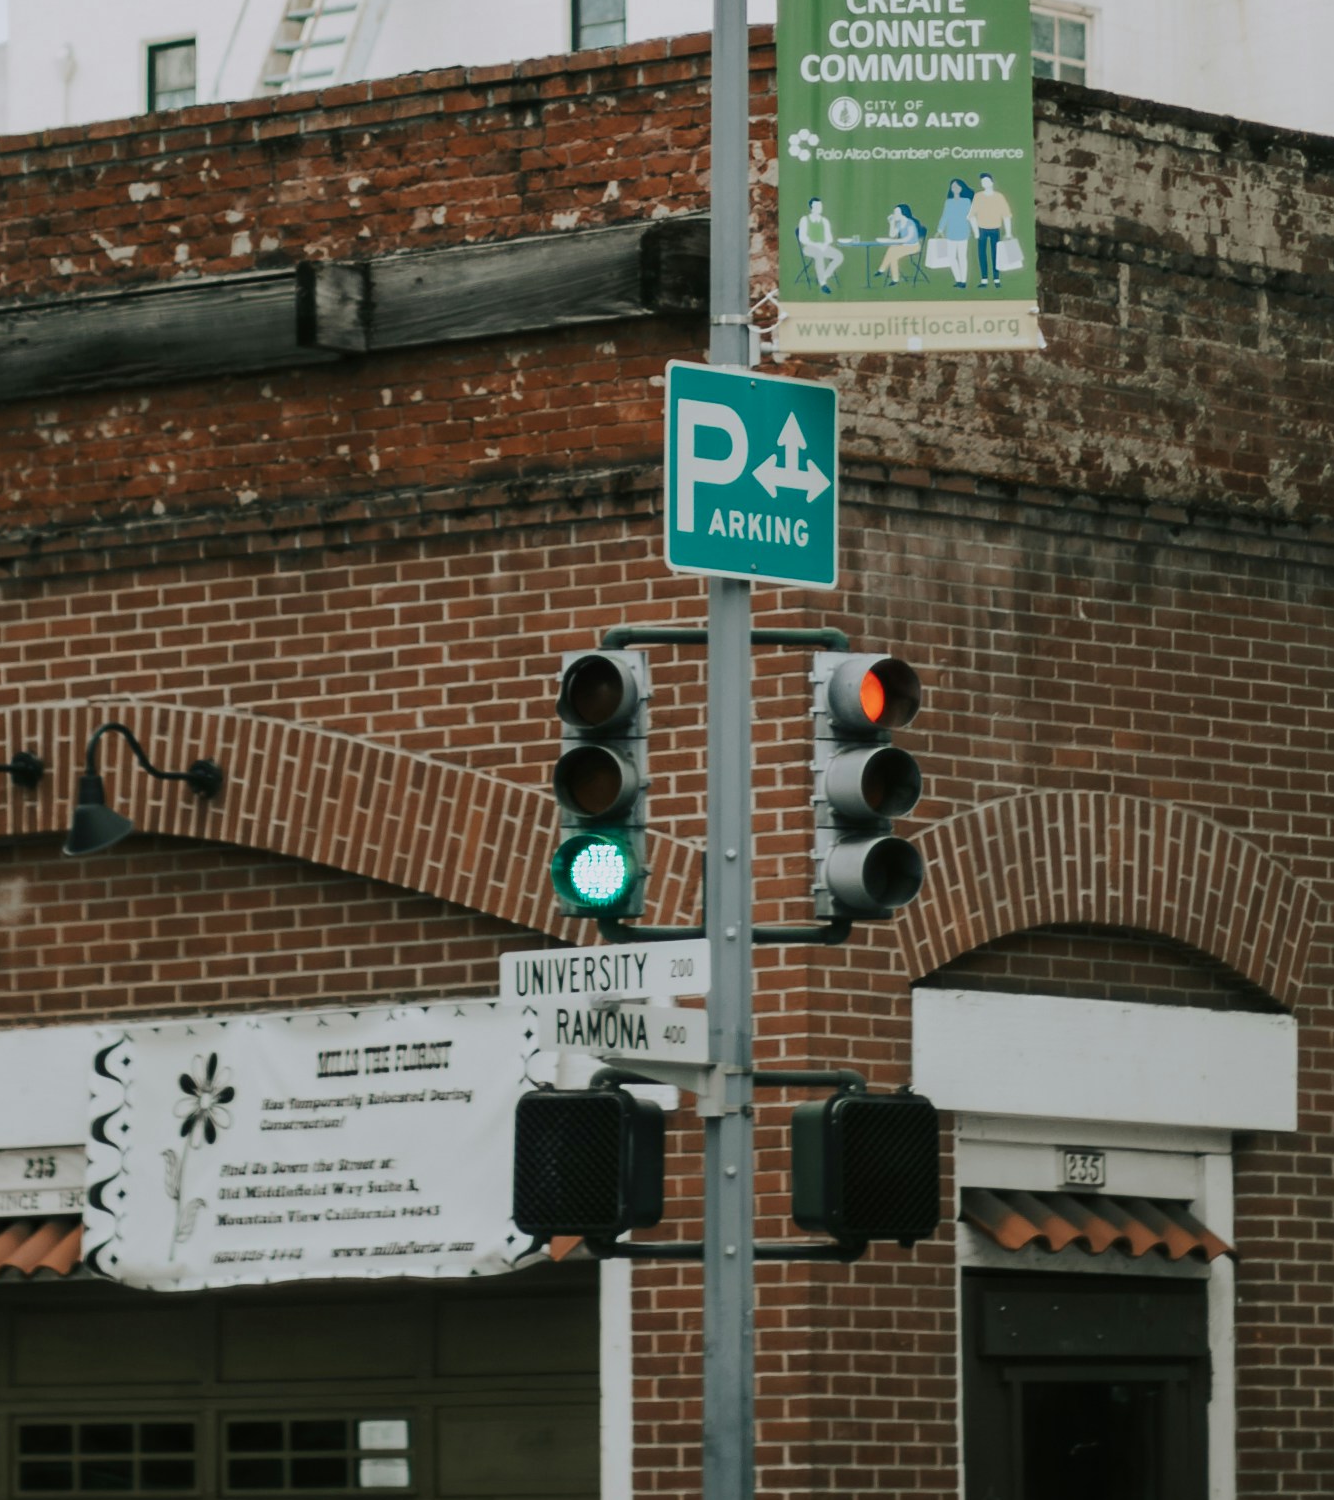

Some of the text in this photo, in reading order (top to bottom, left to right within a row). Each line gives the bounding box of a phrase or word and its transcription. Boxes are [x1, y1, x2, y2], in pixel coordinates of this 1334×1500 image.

[828, 19, 987, 48] CONNECT
[800, 53, 1016, 82] COMMUNITY
[864, 100, 924, 111] CITY OF
[864, 111, 980, 128] PALO ALTO
[816, 146, 1024, 160] Palo Alto Chamber of Commerce
[797, 314, 1021, 338] www.upliftlocal.org
[515, 952, 694, 996] UNIVERSITY 200
[556, 1008, 686, 1050] RAMONA 400
[317, 1049, 359, 1078] MILLS
[396, 1040, 452, 1071] FLORIST
[1069, 1155, 1099, 1182] 235
